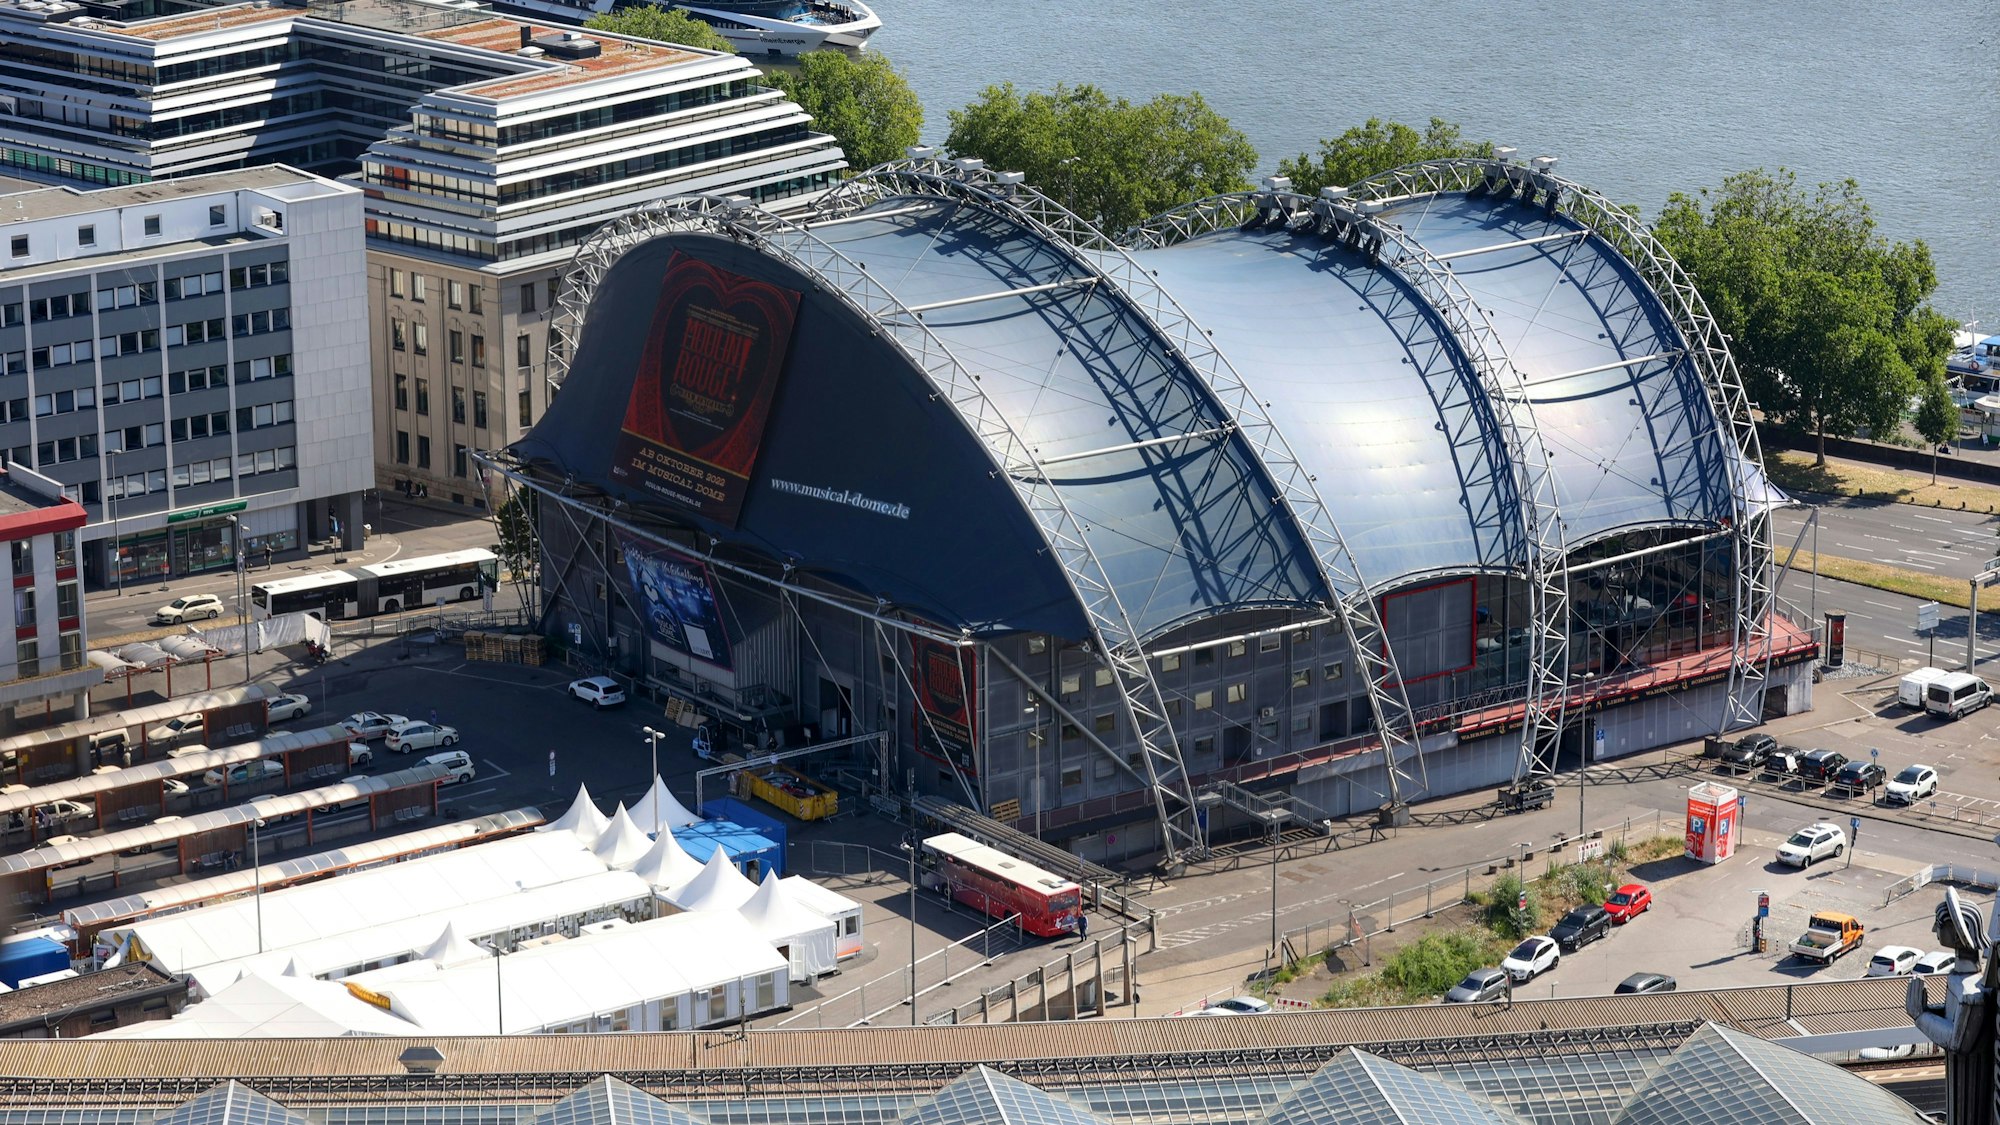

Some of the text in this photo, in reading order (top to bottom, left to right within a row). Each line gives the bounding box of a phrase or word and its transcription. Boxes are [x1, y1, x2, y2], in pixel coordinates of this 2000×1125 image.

[759, 36, 806, 45] RheinEnergie
[682, 317, 744, 366] MOULIN
[632, 457, 645, 471] IM
[647, 463, 694, 489] MUSICAL
[696, 483, 726, 502] DOME
[639, 446, 726, 488] AB OKTOBER 2022
[771, 476, 910, 520] www.musical-dome.de
[1693, 818, 1701, 832] P
[1720, 821, 1727, 836] P
